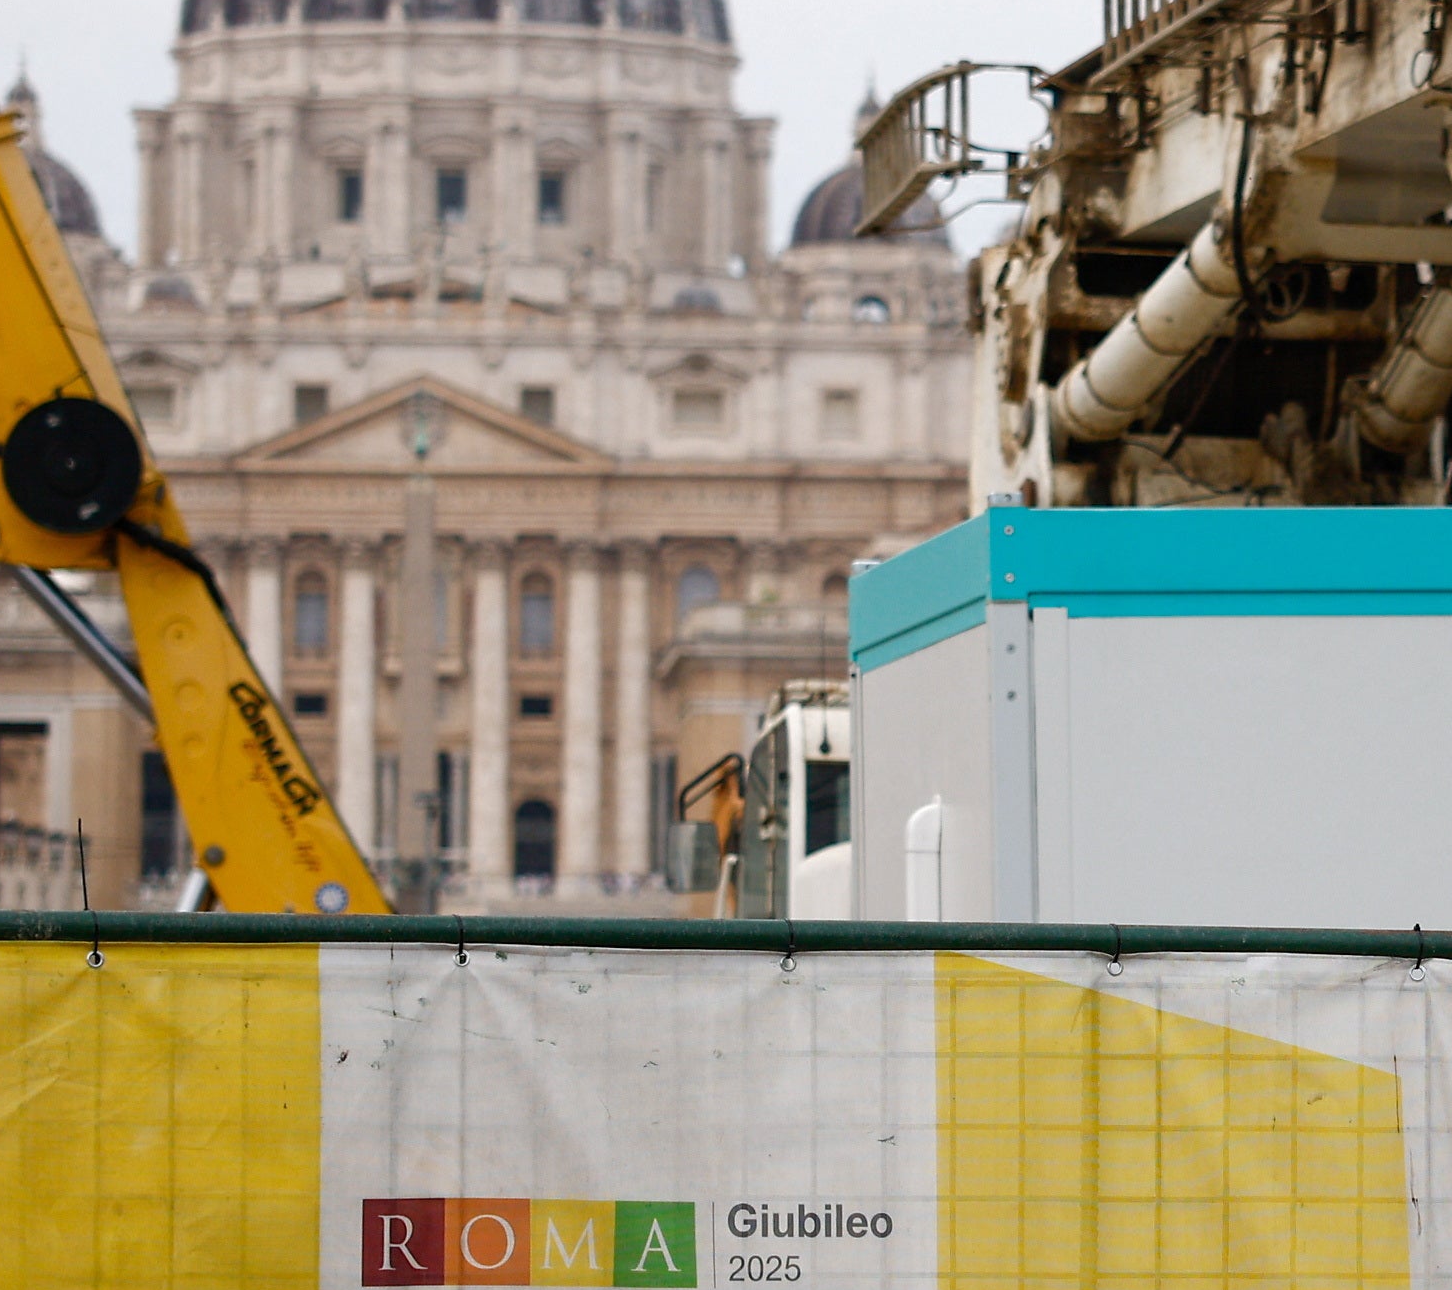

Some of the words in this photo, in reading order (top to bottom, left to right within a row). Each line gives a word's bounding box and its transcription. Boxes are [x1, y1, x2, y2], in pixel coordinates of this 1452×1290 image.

[727, 1202, 893, 1240] Giubileo
[377, 1214, 683, 1272] ROMA
[728, 1254, 802, 1283] 2025
